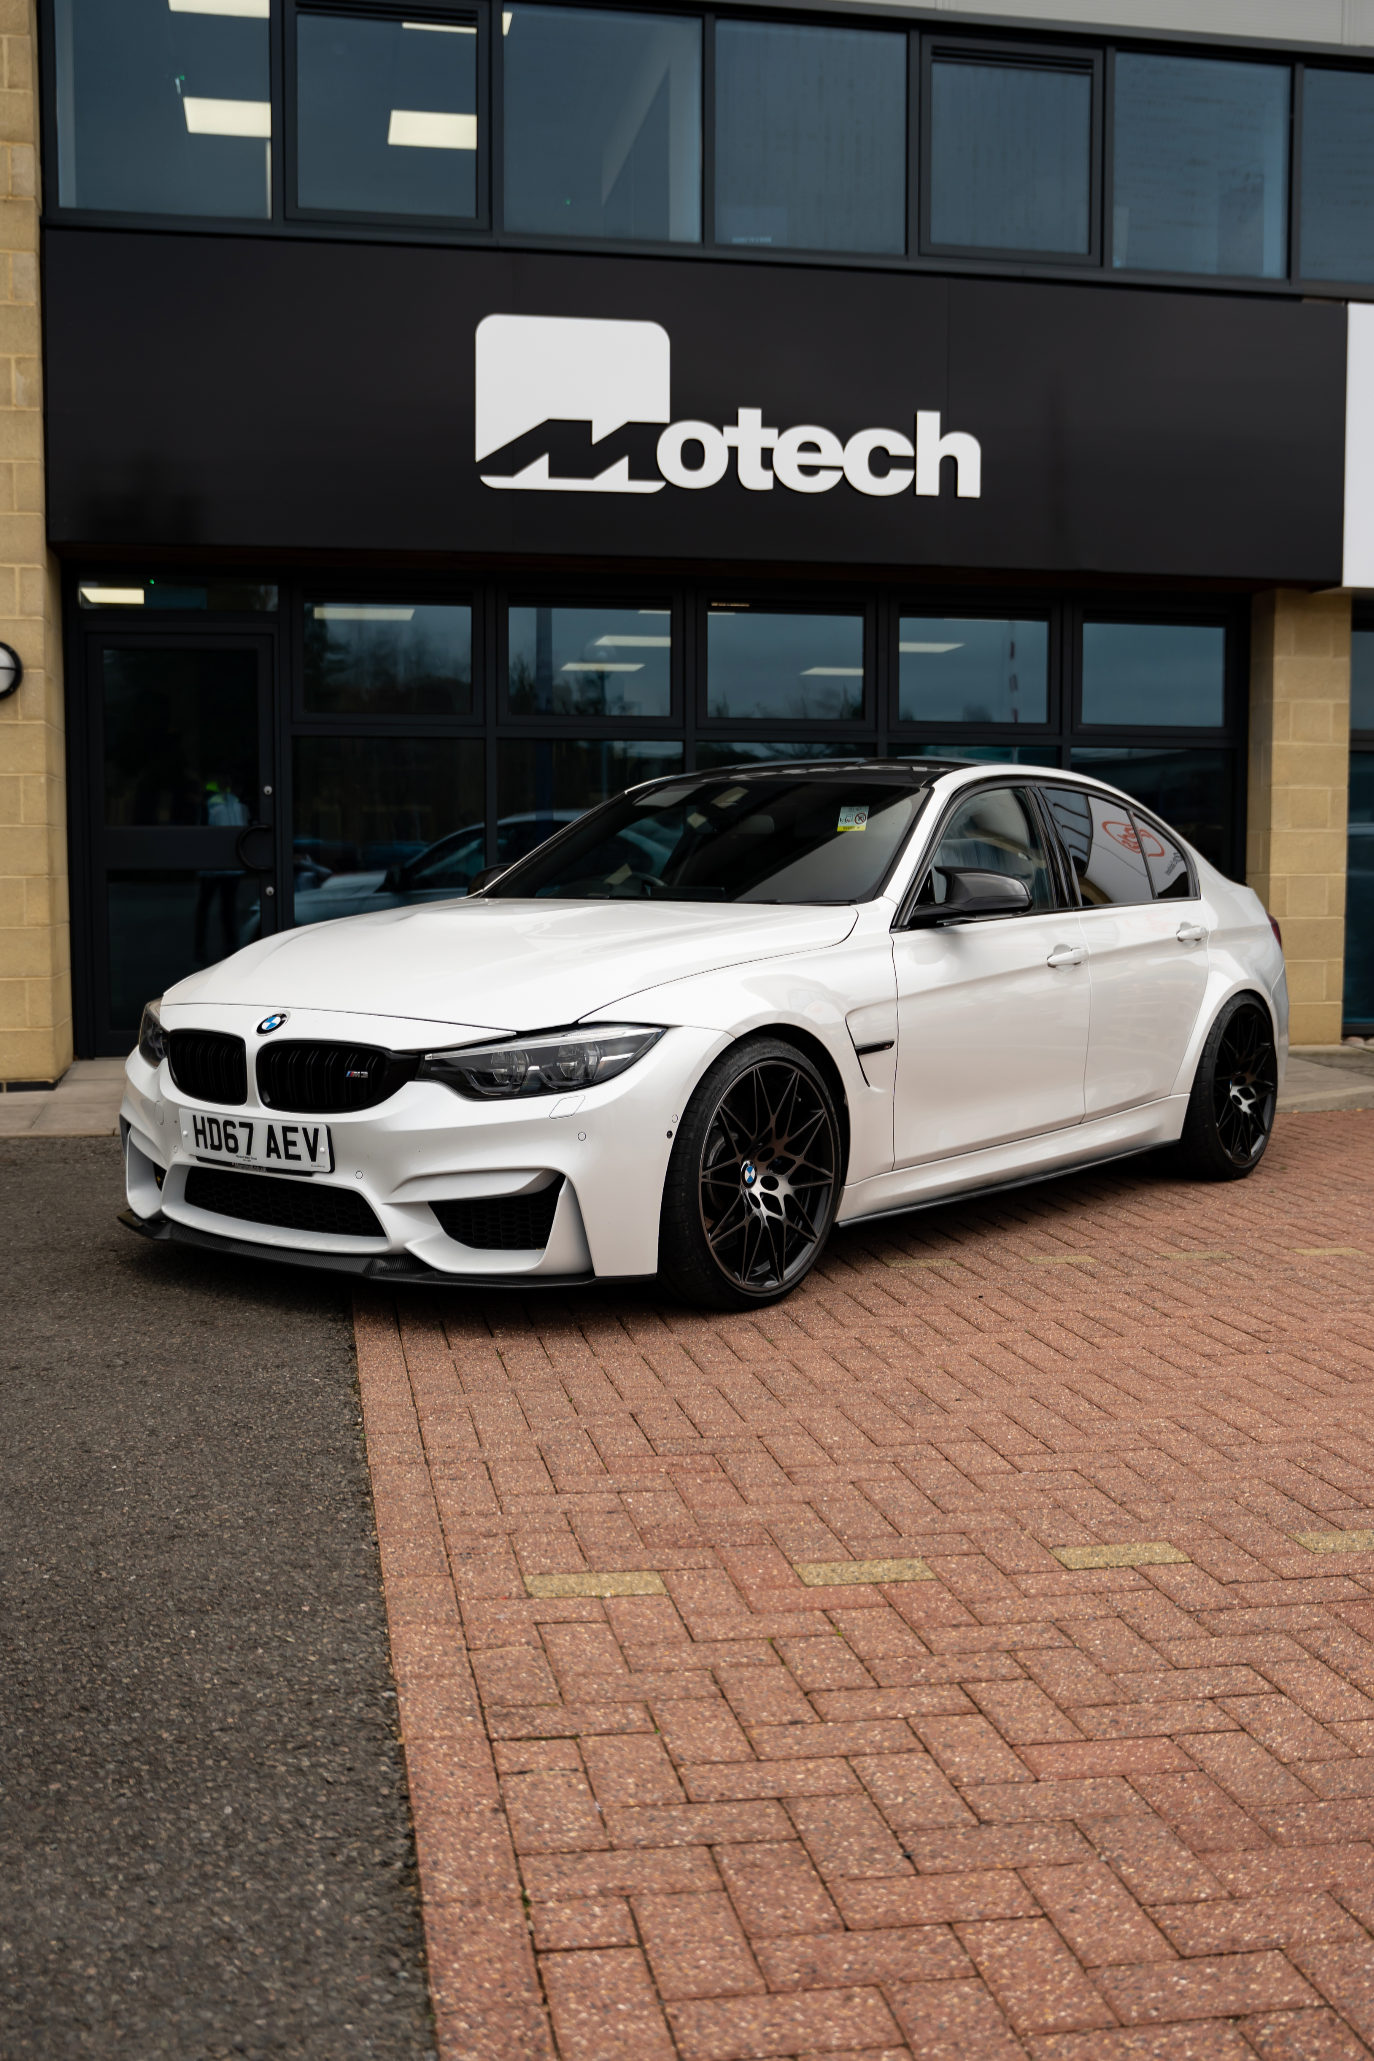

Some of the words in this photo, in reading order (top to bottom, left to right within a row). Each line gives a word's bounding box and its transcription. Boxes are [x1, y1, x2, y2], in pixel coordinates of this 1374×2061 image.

[475, 313, 982, 499] Motech
[346, 1070, 369, 1079] M3
[192, 1114, 254, 1156] HD67
[266, 1124, 320, 1163] AEV
